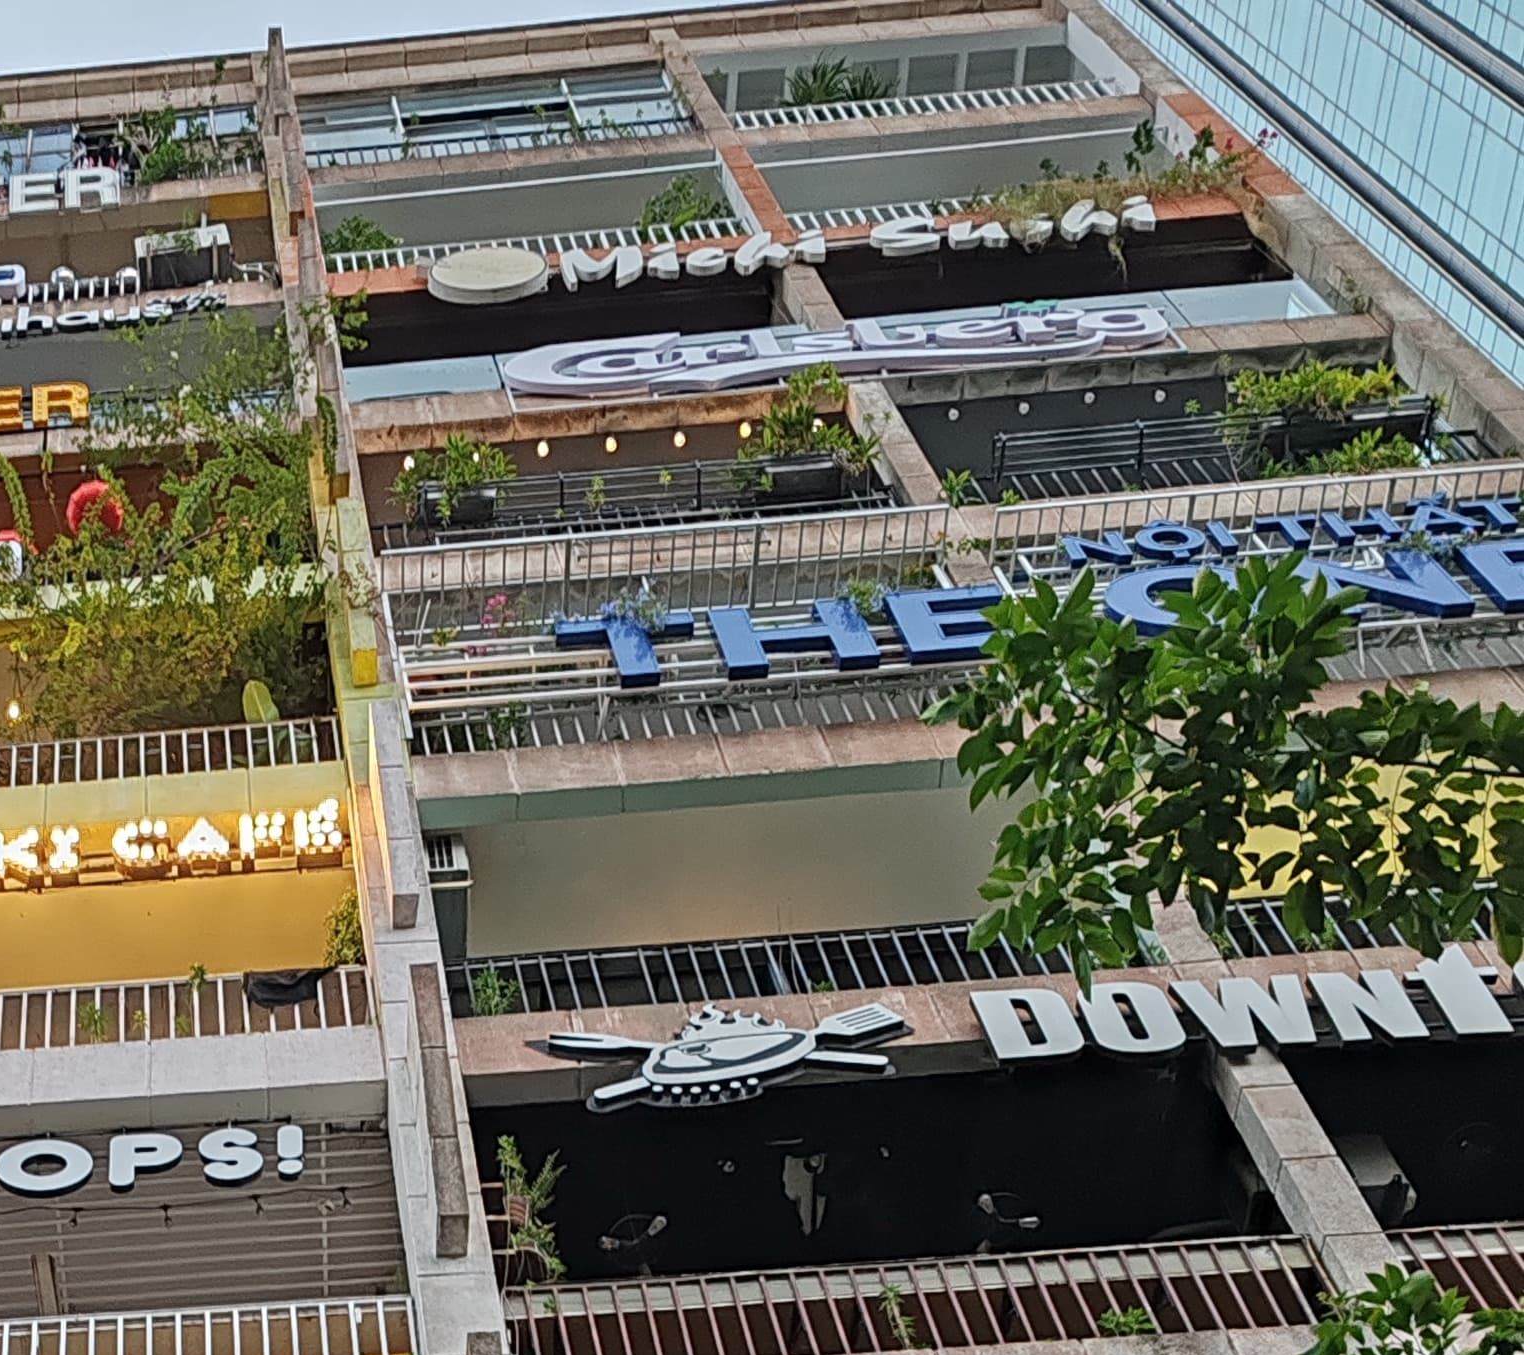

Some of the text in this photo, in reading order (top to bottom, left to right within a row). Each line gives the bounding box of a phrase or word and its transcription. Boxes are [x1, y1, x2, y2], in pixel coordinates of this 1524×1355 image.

[560, 228, 826, 291] Michi
[505, 304, 1169, 395] Carlsberg
[555, 582, 1006, 688] THE
